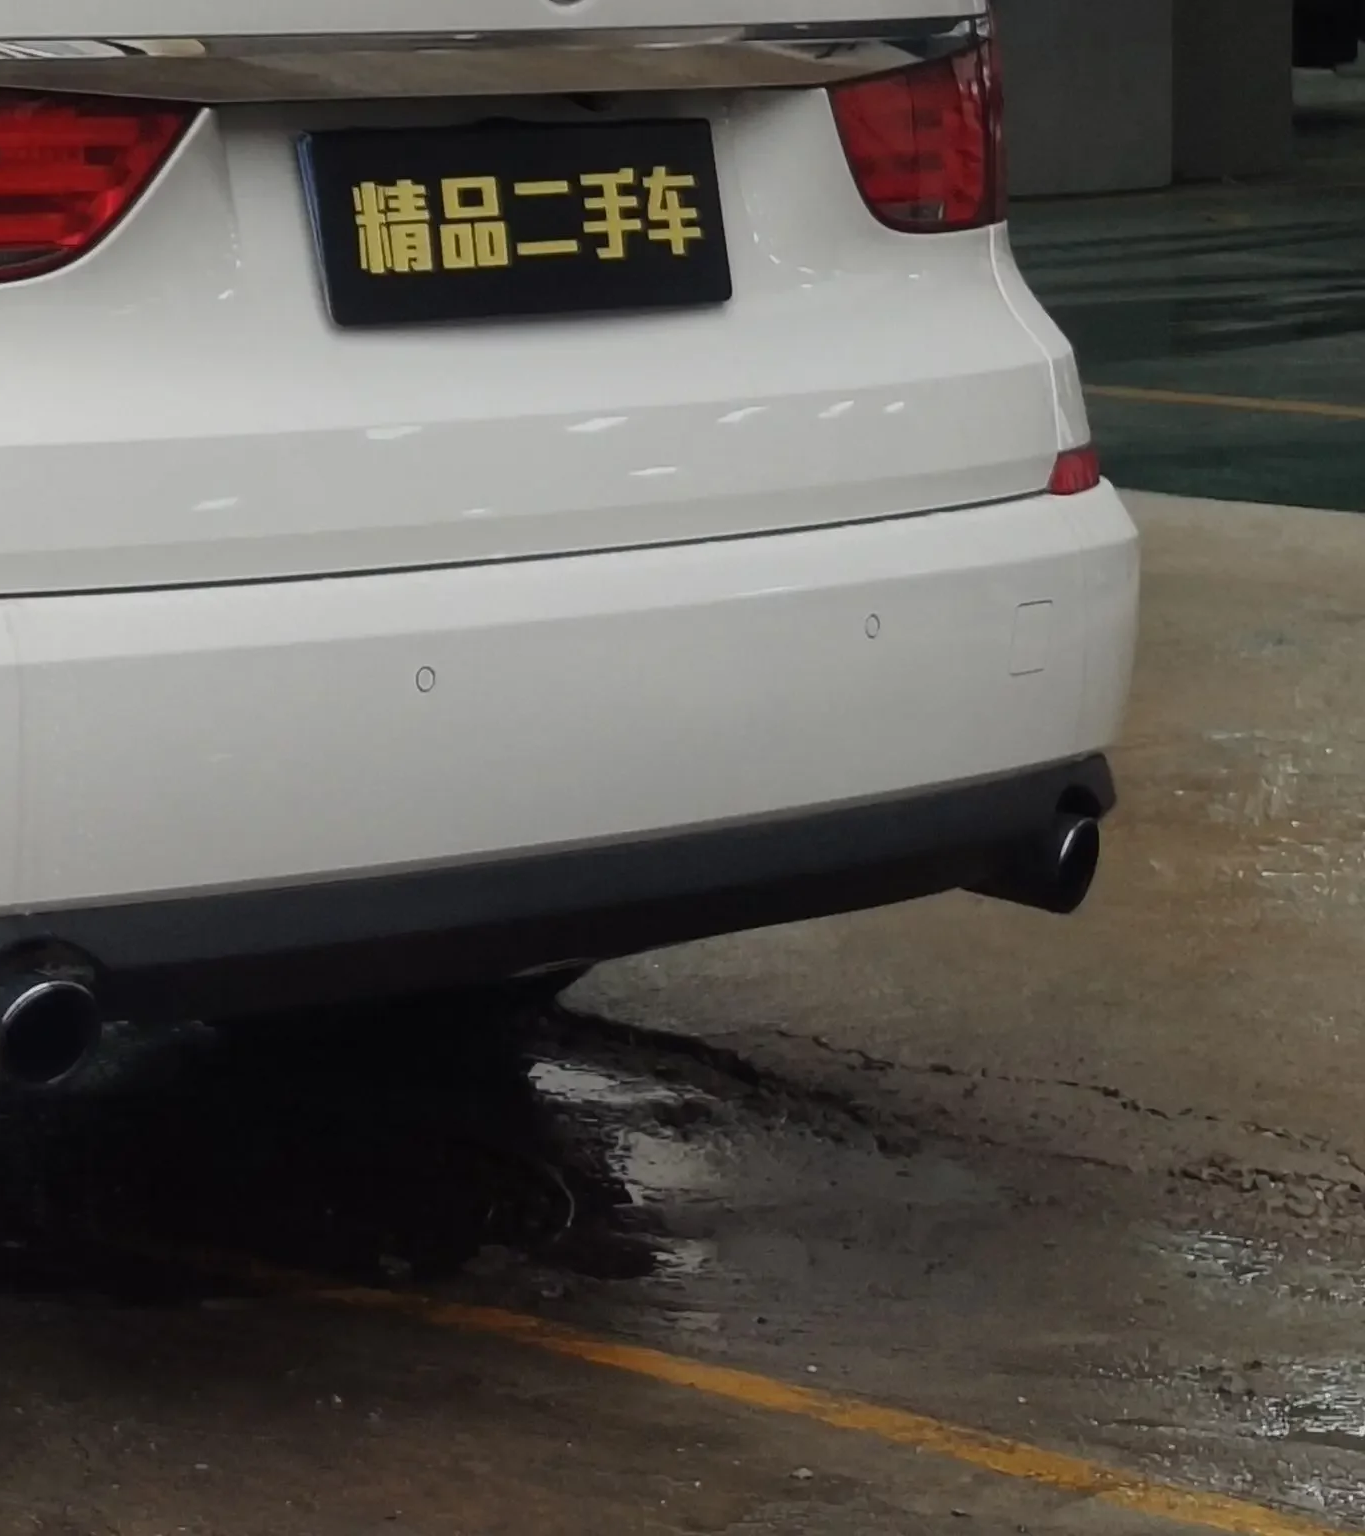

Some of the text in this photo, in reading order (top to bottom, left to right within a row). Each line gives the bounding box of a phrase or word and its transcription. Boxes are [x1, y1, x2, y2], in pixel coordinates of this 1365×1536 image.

[352, 166, 703, 275] 精品二手车
